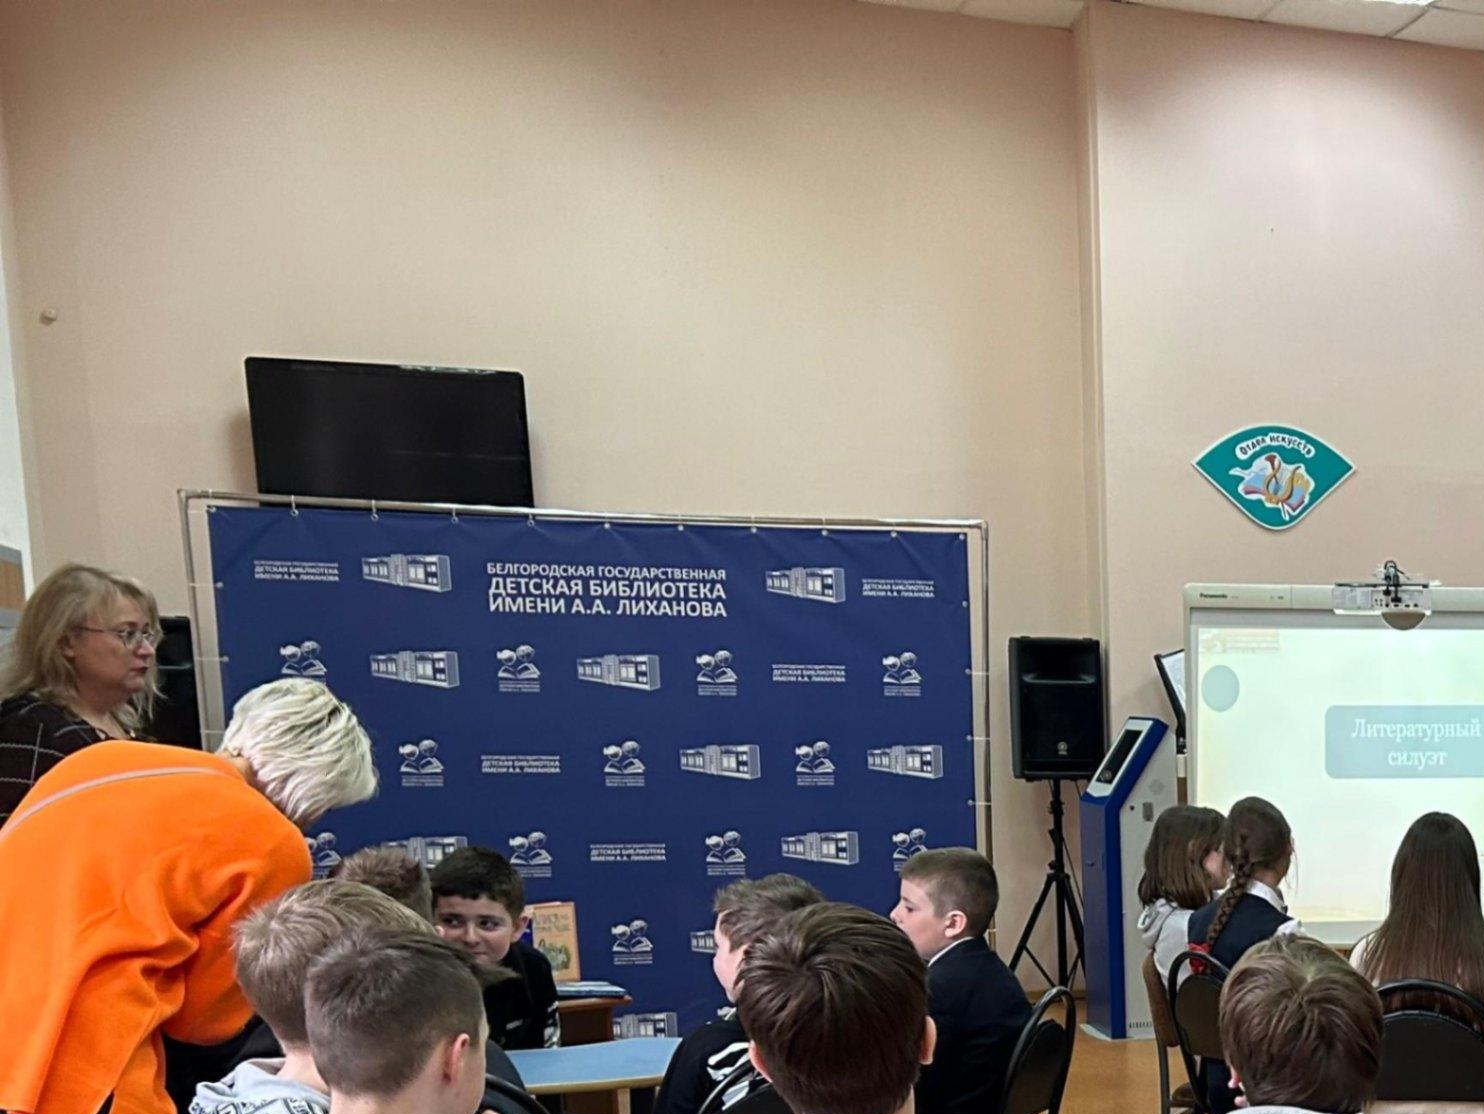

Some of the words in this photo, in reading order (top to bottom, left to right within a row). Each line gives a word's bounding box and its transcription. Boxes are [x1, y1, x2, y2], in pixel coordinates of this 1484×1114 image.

[487, 563, 594, 577] БЕЛГОРОДСКАЯ
[598, 566, 726, 581] ГОСУДАРСТВЕННАЯ
[489, 577, 583, 597] ДЕТСКАЯ
[589, 580, 727, 599] БИБЛИОТЕКА
[489, 598, 565, 613] ИМЕНИ
[571, 599, 611, 615] А.А.
[616, 600, 727, 617] ЛИХАНОВА
[1351, 718, 1481, 742] Литературный
[1388, 750, 1447, 770] силуэт
